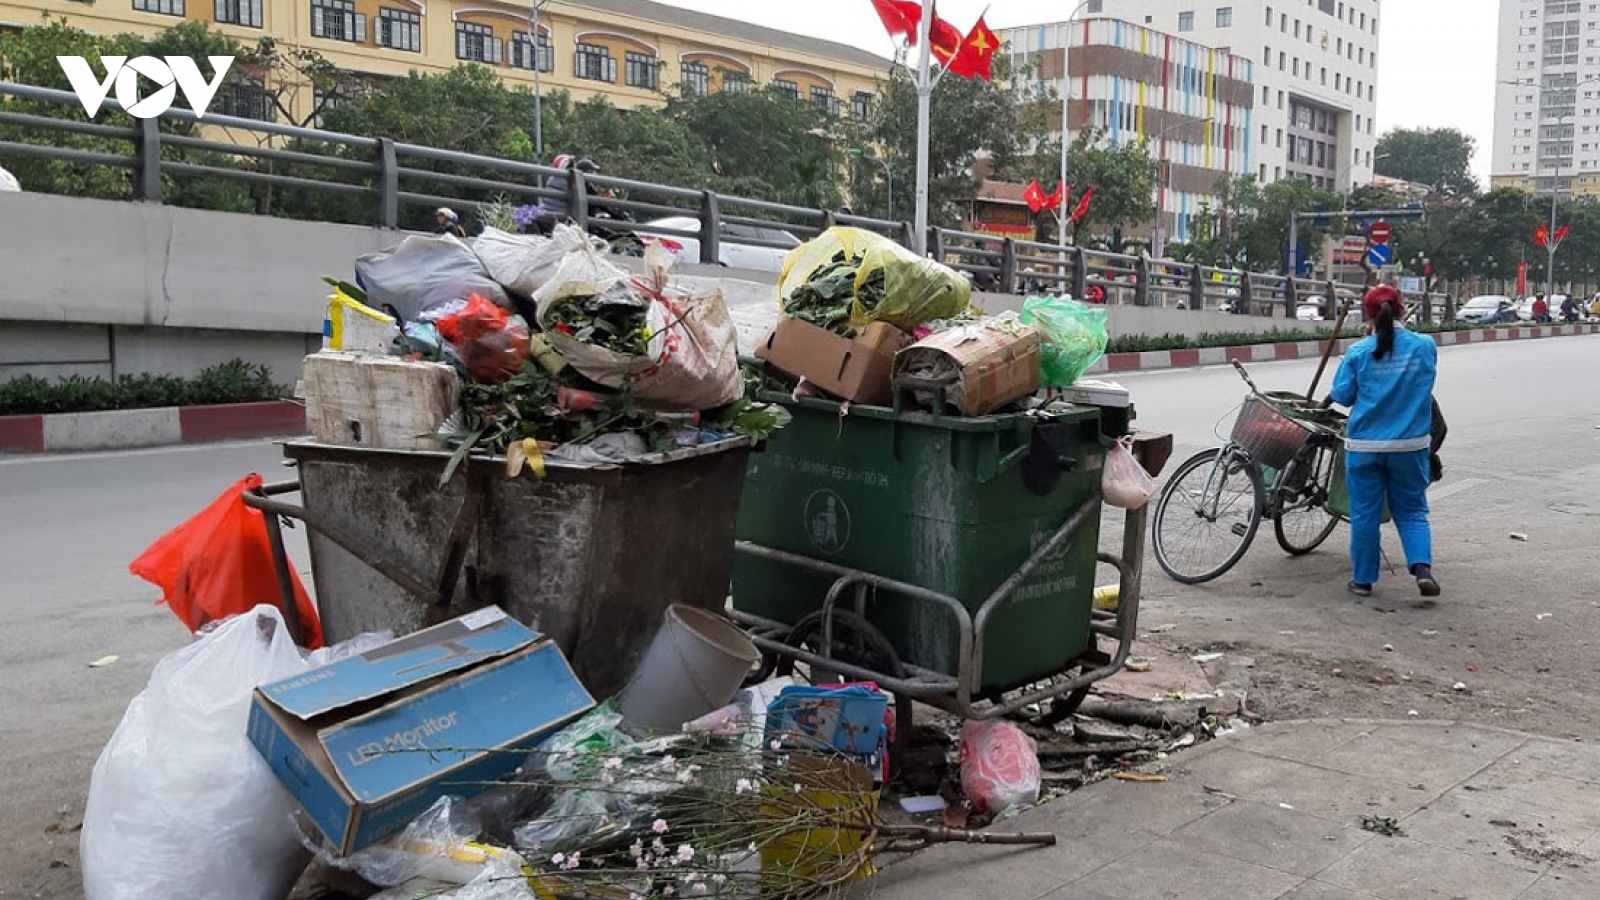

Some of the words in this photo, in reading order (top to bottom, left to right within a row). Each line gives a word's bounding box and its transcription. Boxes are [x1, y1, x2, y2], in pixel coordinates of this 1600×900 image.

[271, 669, 336, 695] SAMSUNG
[347, 741, 385, 766] LED
[384, 711, 457, 752] Monitor
